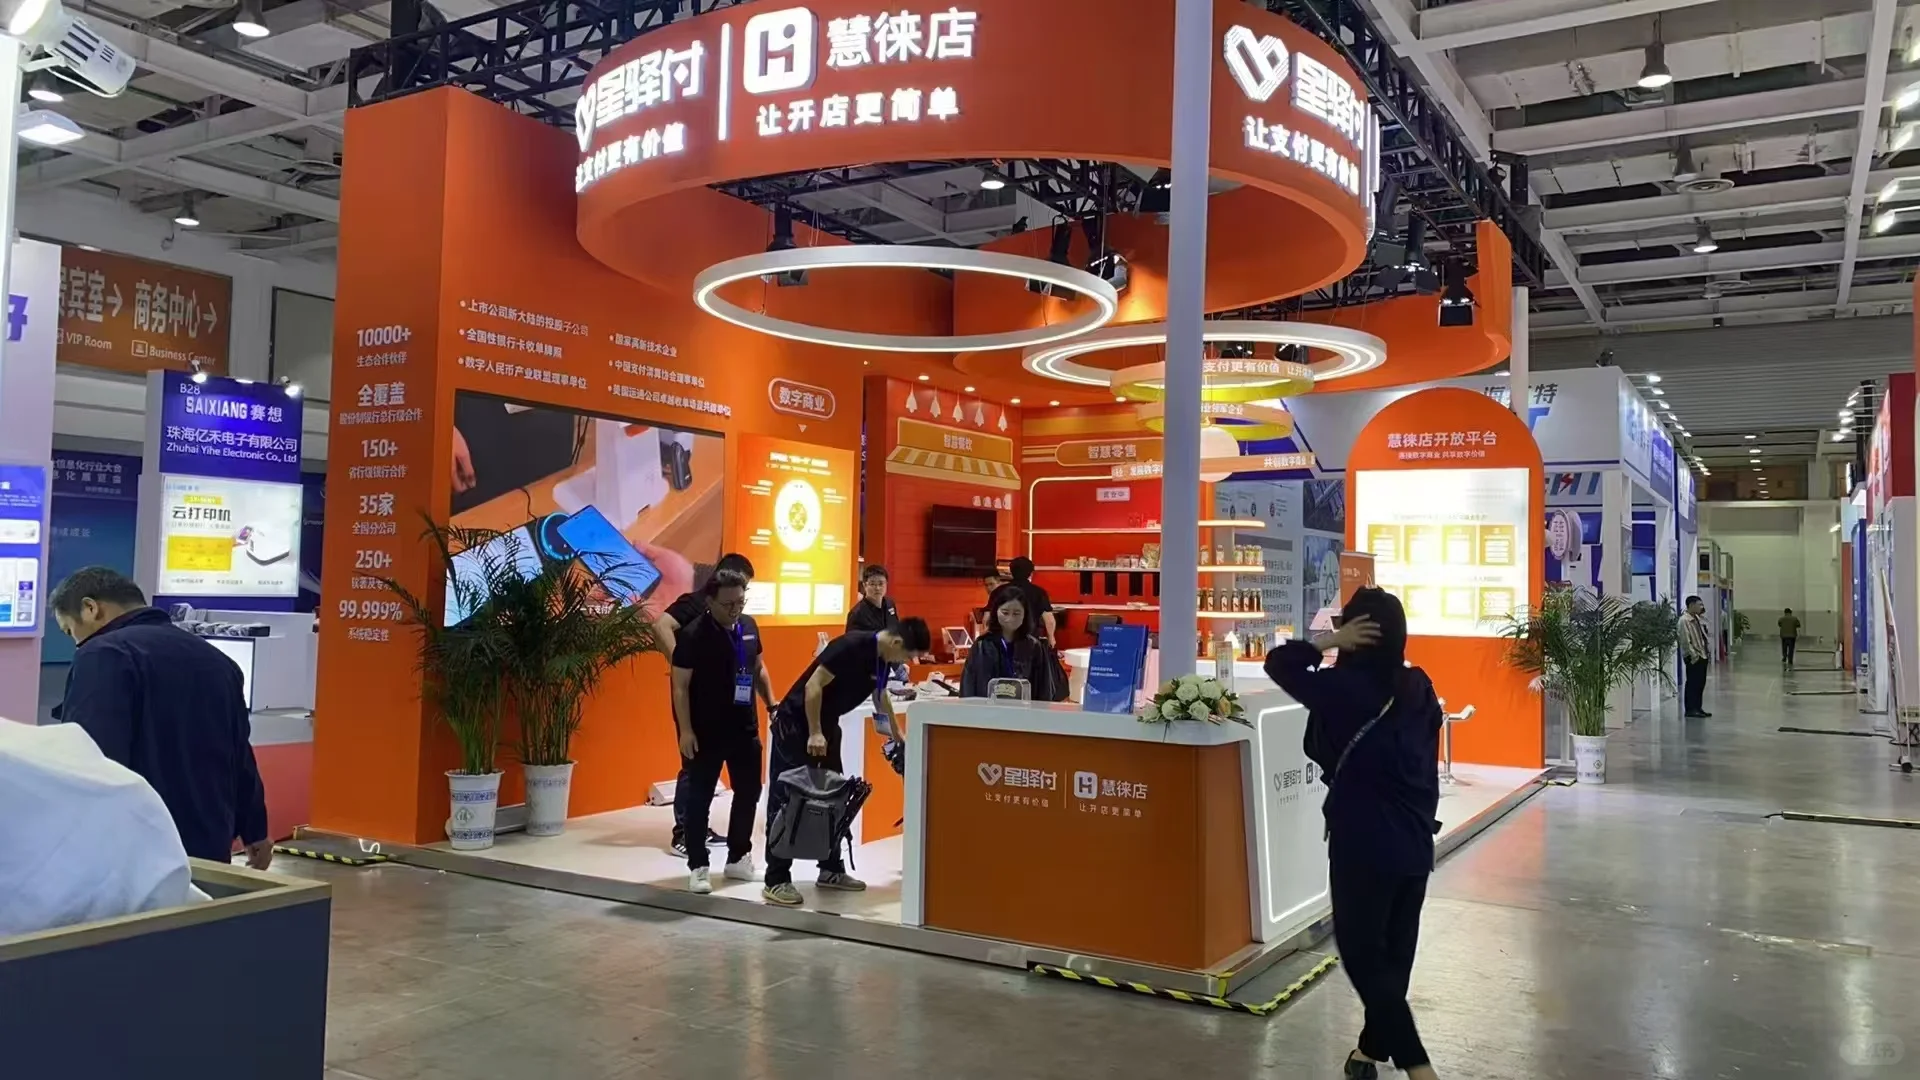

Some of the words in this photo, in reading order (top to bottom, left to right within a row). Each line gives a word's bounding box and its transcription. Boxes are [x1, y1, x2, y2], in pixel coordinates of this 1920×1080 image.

[826, 7, 977, 67] 慧徕店
[596, 40, 704, 127] 星驿付
[756, 87, 958, 137] 让开店更简单
[1290, 51, 1366, 150] 星驿付
[575, 121, 686, 193] 让支付更有价值
[1243, 115, 1360, 196] 让支付更有价值
[134, 279, 200, 338] 商务中心
[468, 299, 588, 337] 上市公司新大陆的控股子公司
[66, 332, 83, 345] VIP
[84, 336, 112, 350] Room
[356, 325, 412, 347] 10000+
[466, 328, 562, 358] 全国性银行卡收单牌照
[615, 333, 677, 358] 国家高新技术企业
[149, 346, 186, 361] Business
[356, 352, 407, 367] 生态合作伙伴
[465, 356, 587, 389] 数字人民币产业联盟理事单位
[614, 360, 705, 388] 中国支付清算协会理事单位
[180, 383, 200, 395] B28
[358, 382, 405, 407] 全覆盖
[779, 386, 825, 412] 数字商业
[186, 396, 247, 420] SAIXIANG
[251, 404, 282, 423] 赛想
[339, 408, 423, 425] 股份制银行总行级合作
[167, 426, 297, 452] 珠海亿禾电子有限公司
[361, 439, 398, 458] 150+
[1388, 430, 1497, 449] 慧徕店开放平台
[167, 441, 199, 453] Zhuhai
[201, 446, 221, 456] Yihe
[223, 448, 264, 460] Electronic
[266, 452, 281, 463] Co.,
[284, 454, 298, 463] Ltd
[1088, 444, 1137, 459] 智慧零售
[172, 506, 231, 521] 云打印机
[359, 492, 394, 516] 35家
[352, 521, 396, 535] 全国分公司
[355, 550, 392, 569] 250+
[339, 600, 402, 620] 99.999%
[348, 627, 389, 642] 系统稳定性
[1004, 766, 1057, 791] 星驿付
[1102, 778, 1148, 800] 慧徕店
[985, 791, 1049, 808] 让支付更有价值
[1079, 802, 1142, 818] 让开店更简单
